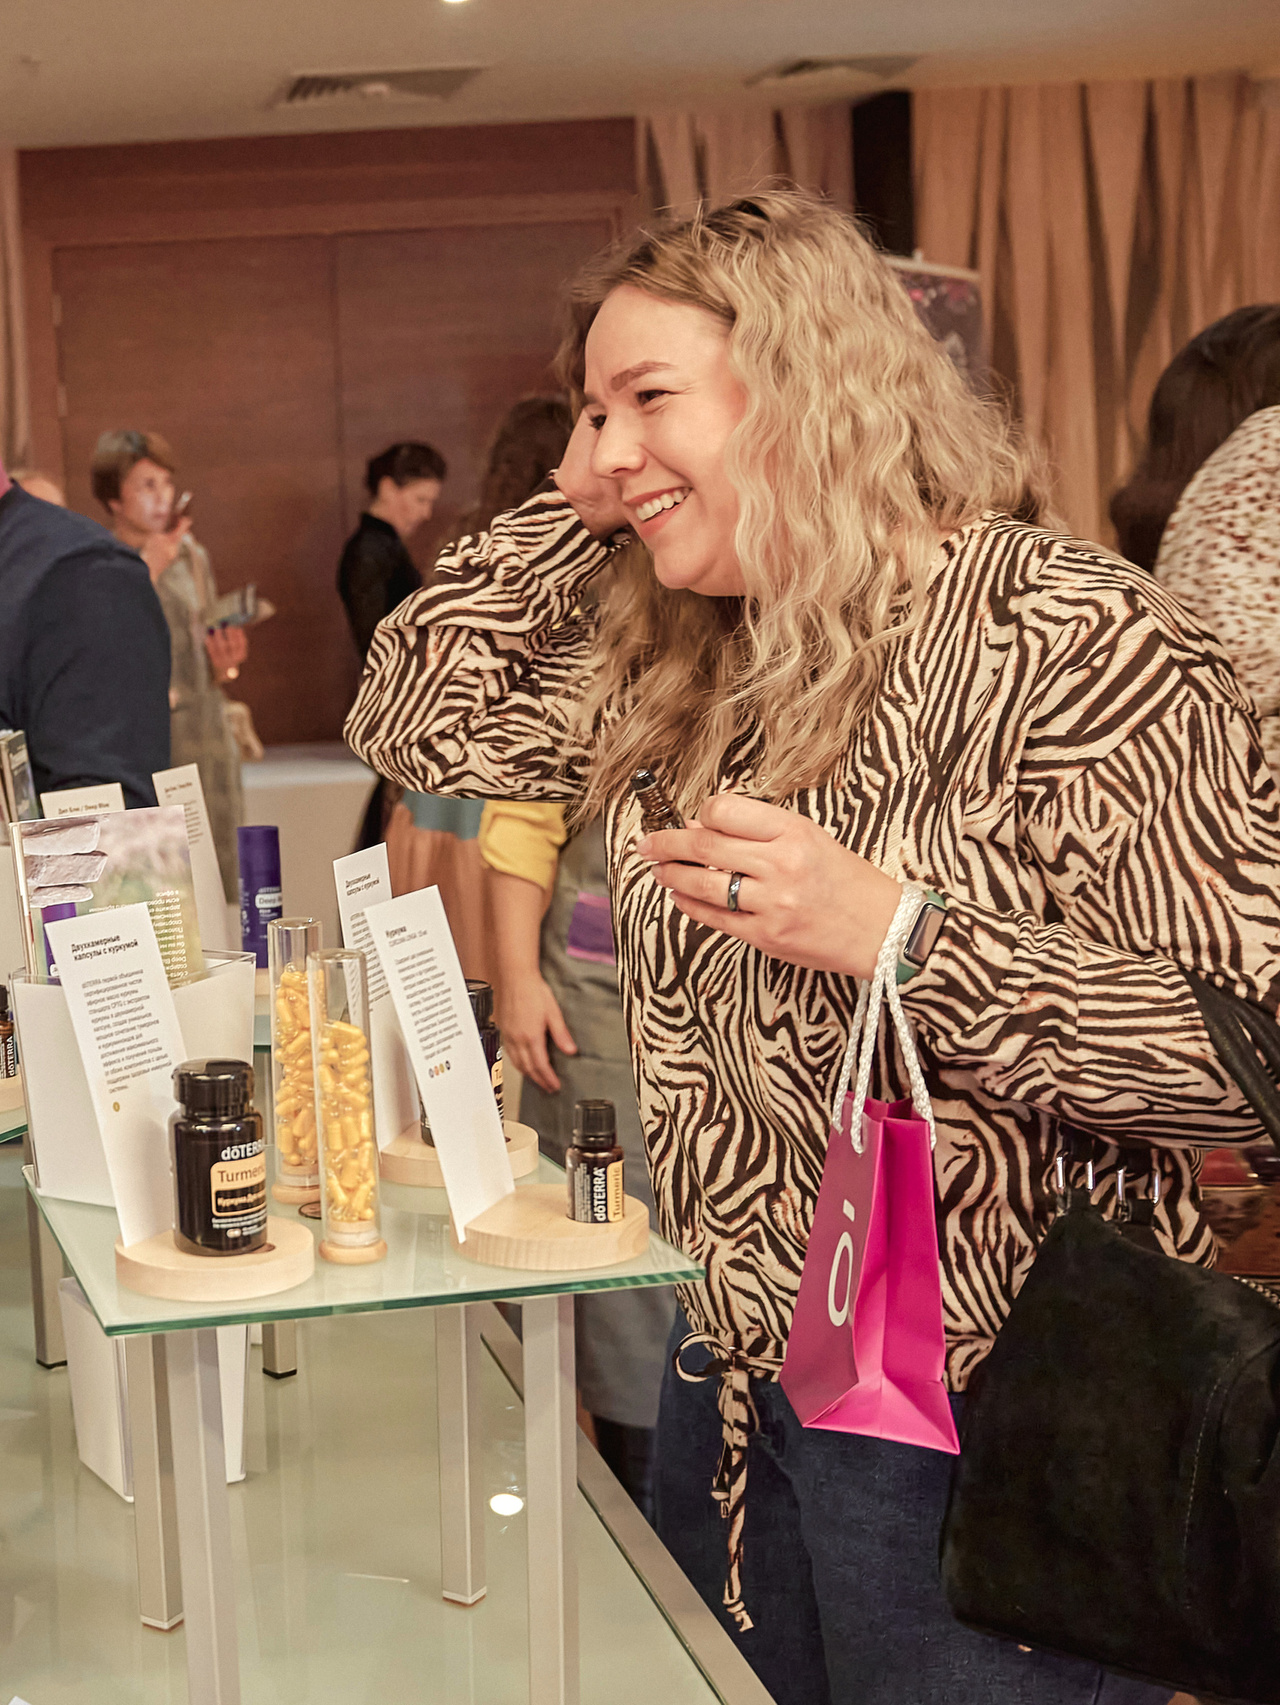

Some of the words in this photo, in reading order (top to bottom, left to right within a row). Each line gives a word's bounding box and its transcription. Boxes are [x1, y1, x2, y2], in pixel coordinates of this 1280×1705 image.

[71, 935, 120, 953] Двухкамерные
[74, 950, 102, 961] капсулы
[108, 939, 138, 954] куркумой
